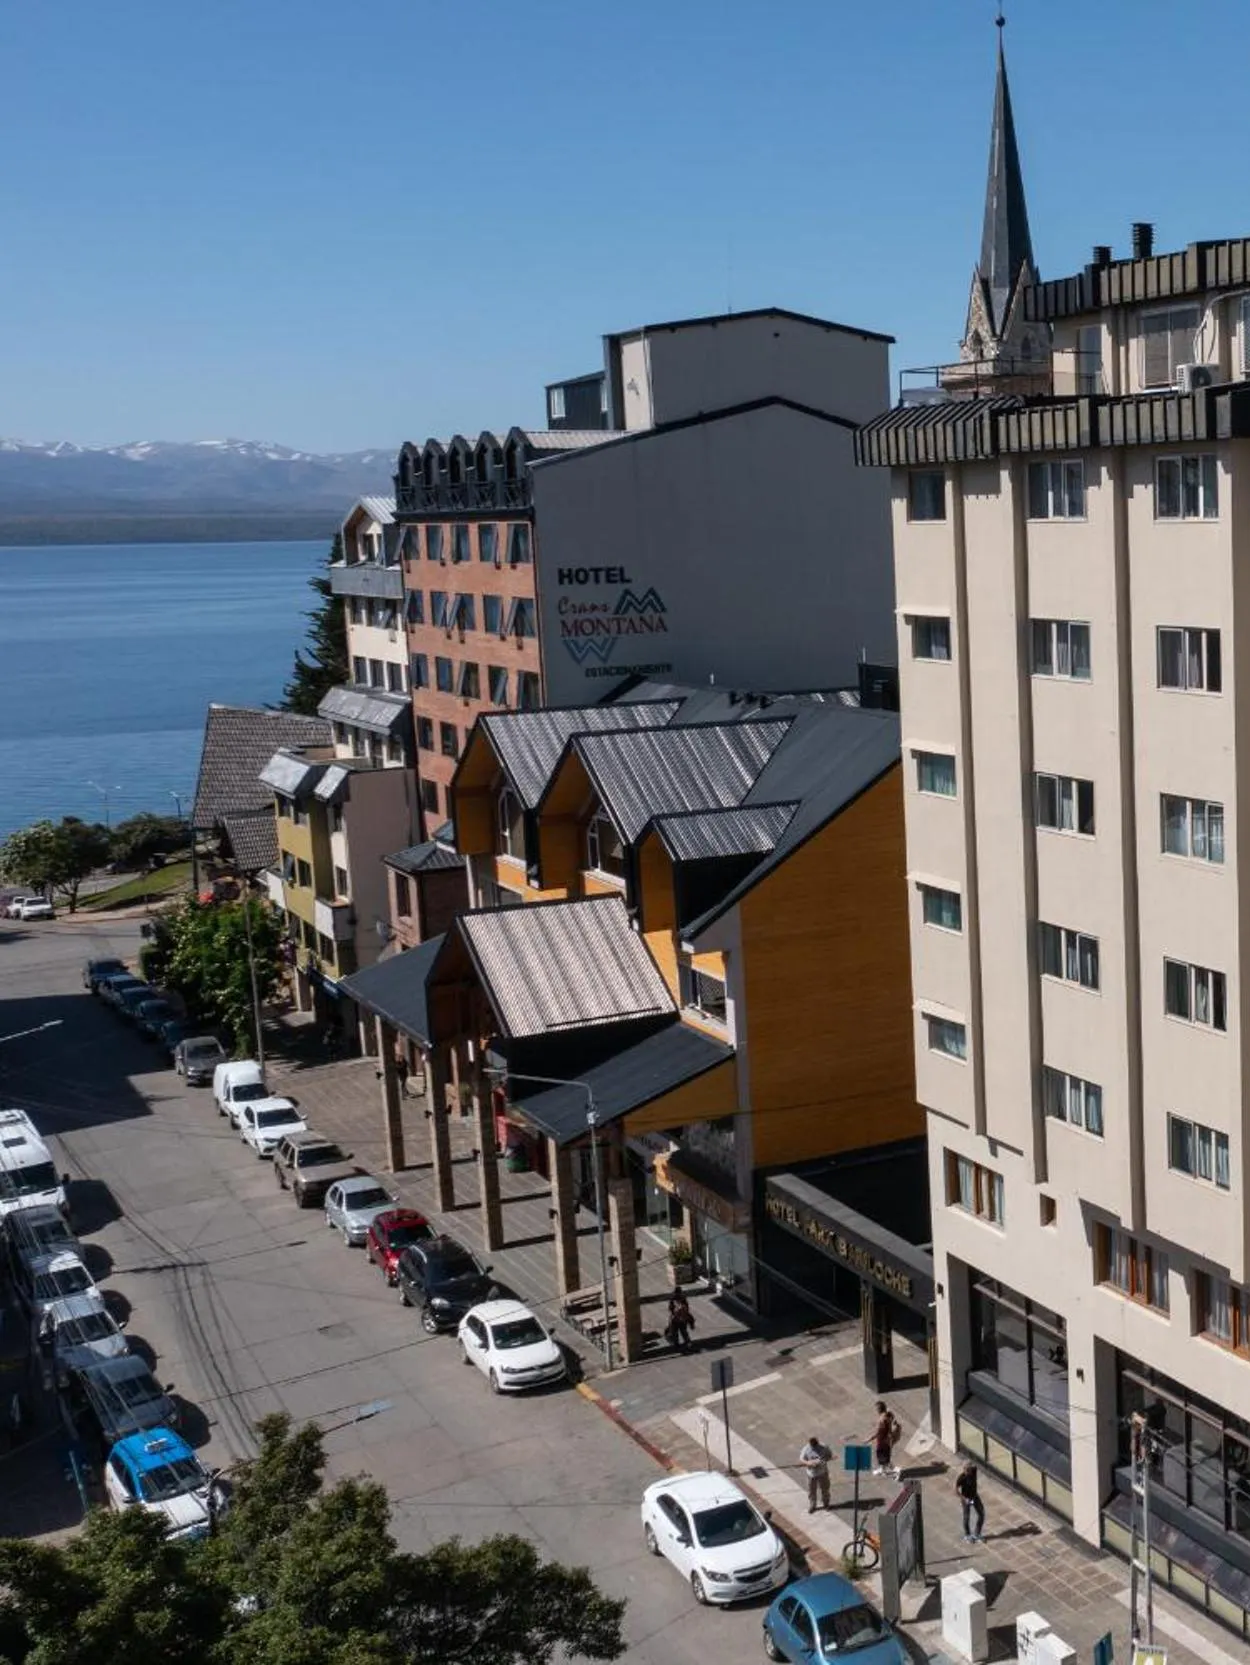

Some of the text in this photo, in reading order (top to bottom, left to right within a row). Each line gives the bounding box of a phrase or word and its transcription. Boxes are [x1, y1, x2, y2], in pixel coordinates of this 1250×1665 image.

[558, 566, 632, 585] HOTEL
[560, 614, 668, 637] MONTANA
[765, 1197, 800, 1227] HOTEL
